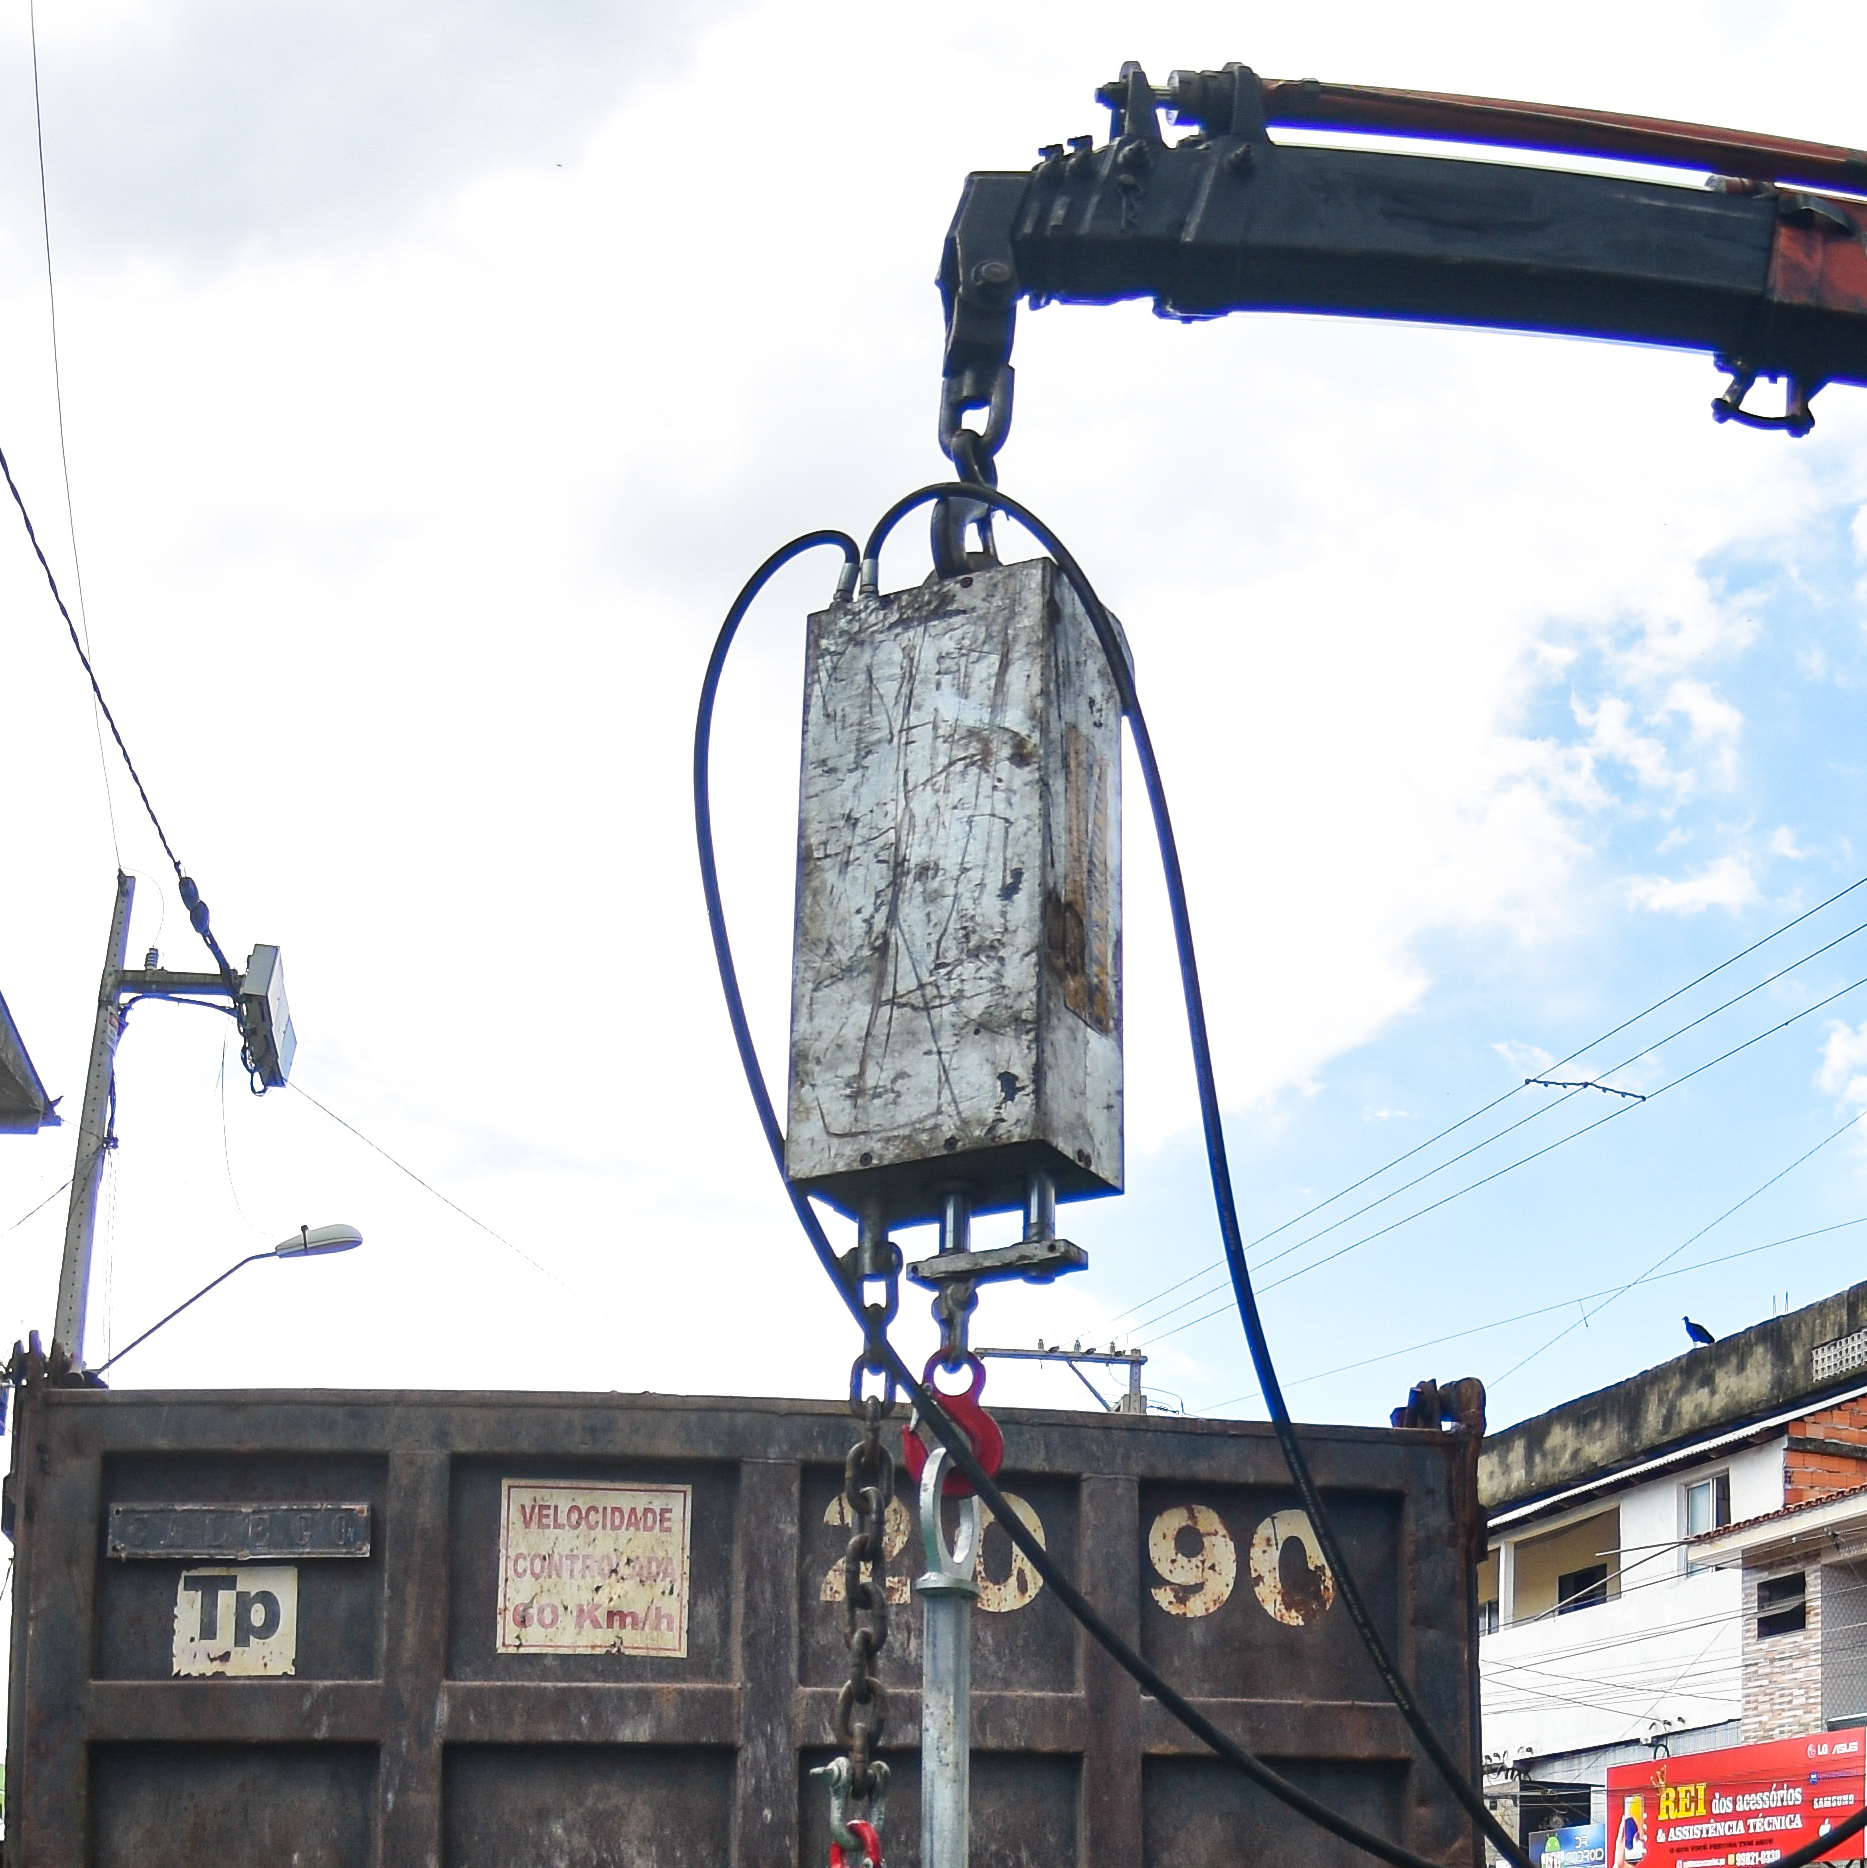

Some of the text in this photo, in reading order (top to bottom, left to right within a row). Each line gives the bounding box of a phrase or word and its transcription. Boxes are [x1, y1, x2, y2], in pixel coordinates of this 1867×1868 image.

[520, 1504, 673, 1533] VELOCIDADE
[1148, 1503, 1335, 1627] 90
[183, 1574, 281, 1648] Tp
[512, 1598, 675, 1632] 60 Km/h
[1817, 1741, 1859, 1756] LG ASUS
[1658, 1783, 1803, 1821] REI dos acessórios
[1813, 1793, 1854, 1810] SAMSUNG
[1656, 1813, 1803, 1843] & ASSISTÊNCIA TÉCNICA
